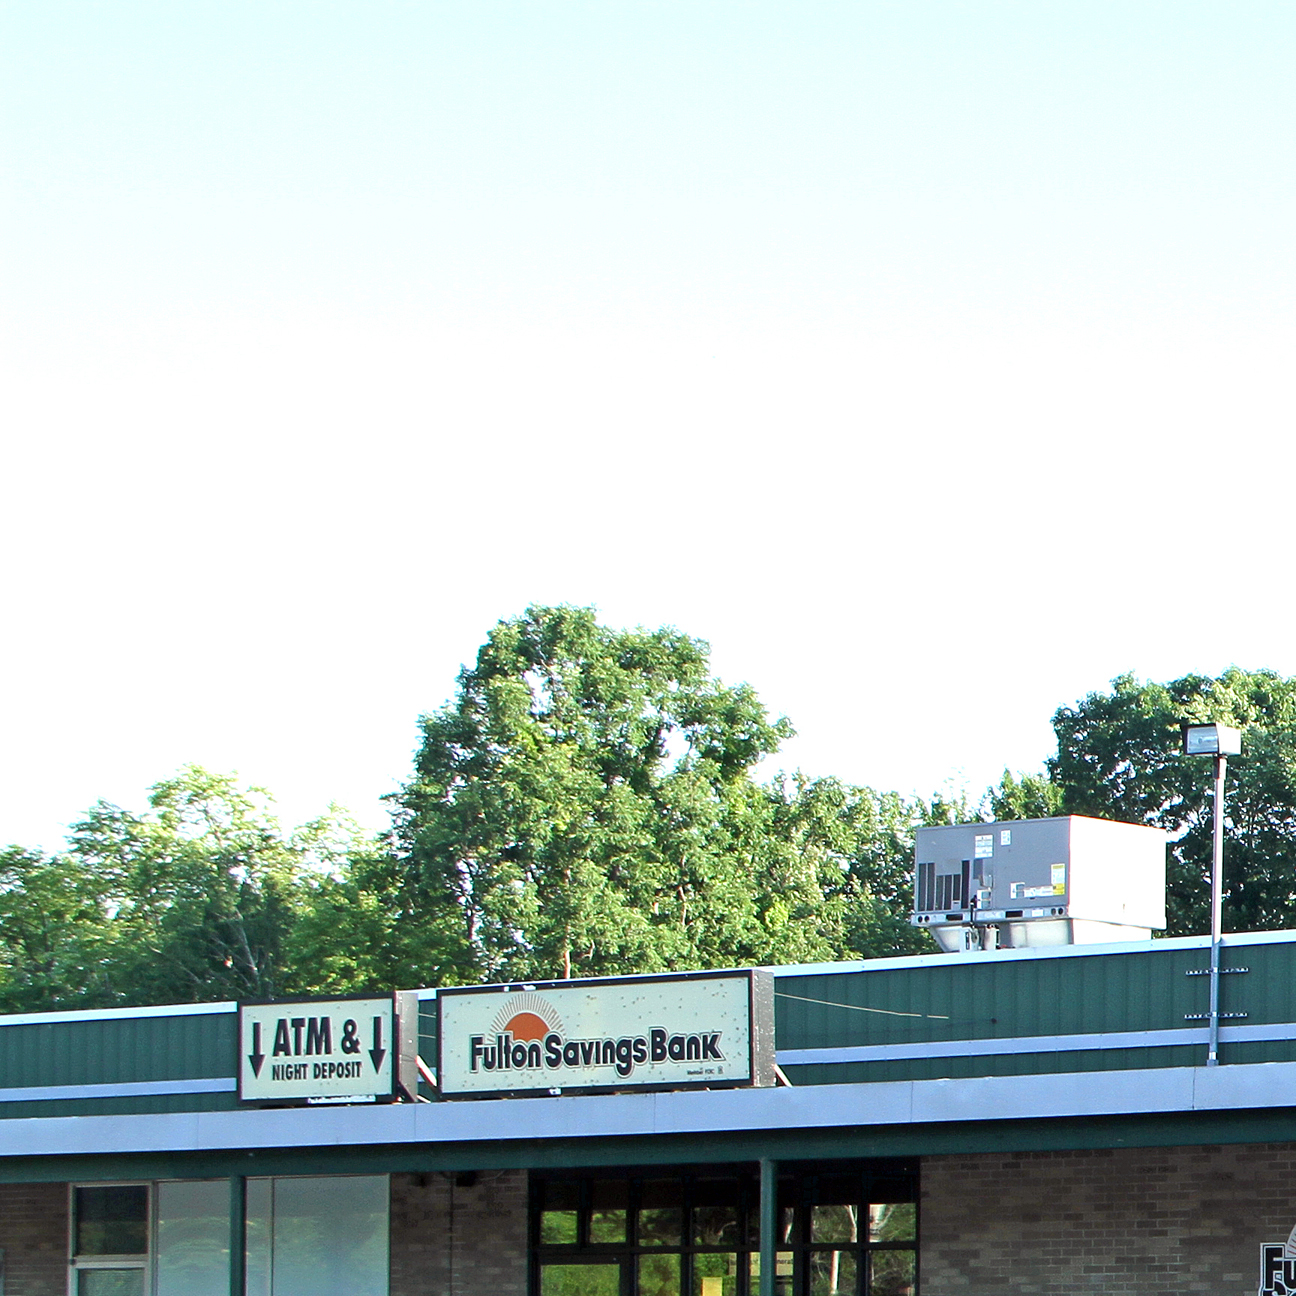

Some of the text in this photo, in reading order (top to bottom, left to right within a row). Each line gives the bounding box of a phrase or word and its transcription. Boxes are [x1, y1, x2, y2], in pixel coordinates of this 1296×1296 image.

[272, 1016, 362, 1057] ATM &
[470, 1028, 722, 1076] Fulton Savings Bank
[272, 1061, 363, 1081] NIGHT DEPOSIT
